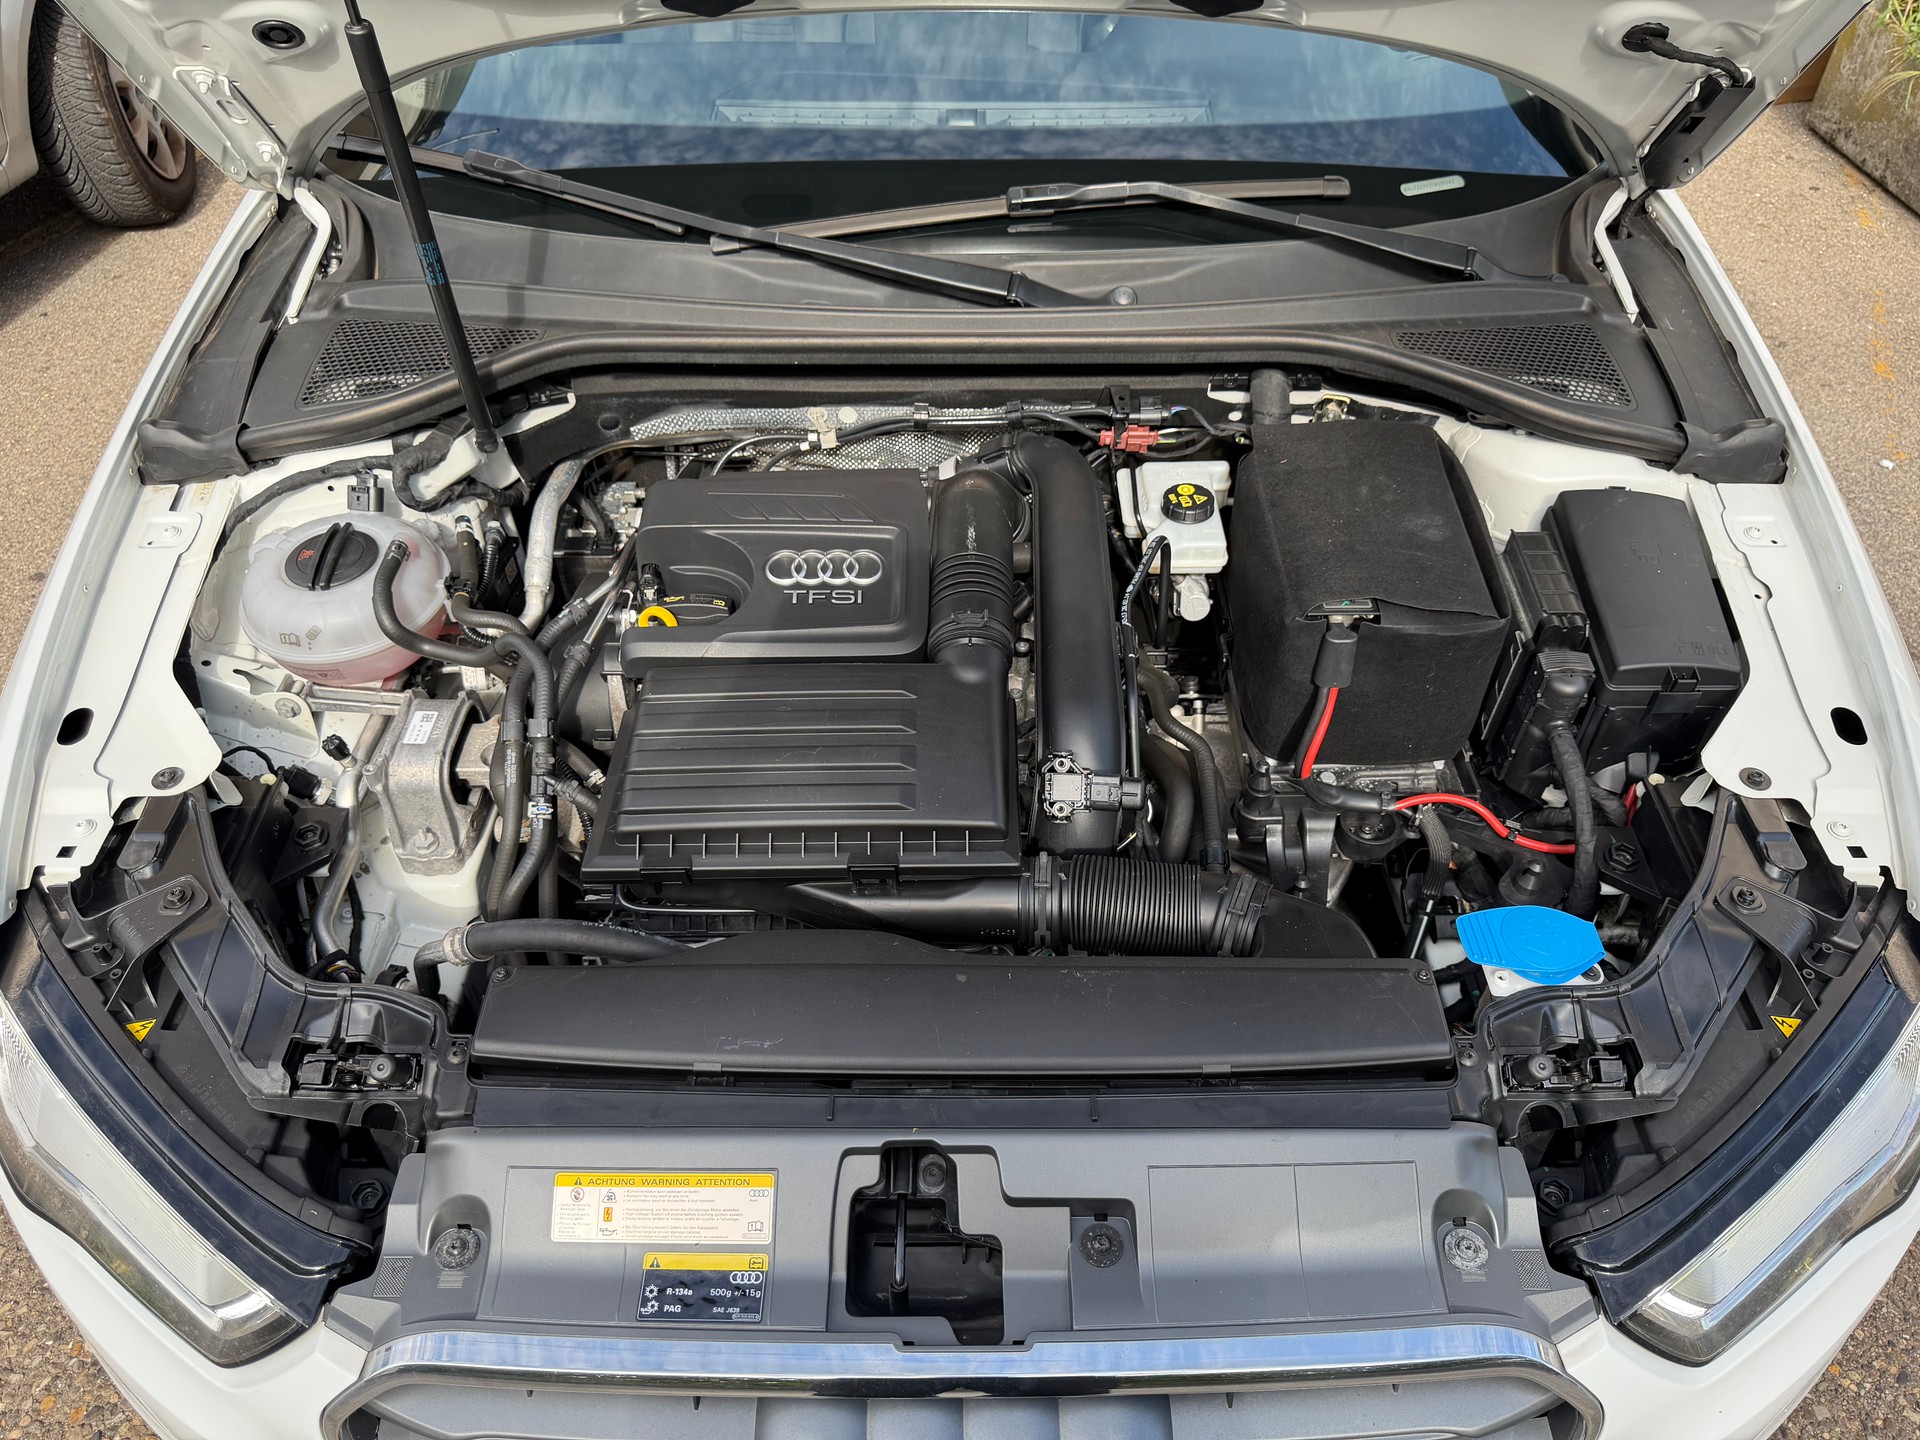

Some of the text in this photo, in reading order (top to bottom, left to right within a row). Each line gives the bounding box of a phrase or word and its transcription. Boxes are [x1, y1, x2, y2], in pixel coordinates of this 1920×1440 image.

[783, 590, 863, 604] TFSI
[587, 1178, 751, 1186] ACHTUNG WARNING ATTENTION
[666, 1287, 693, 1296] R-134a
[710, 1288, 732, 1298] 500g
[663, 1305, 682, 1313] PAG
